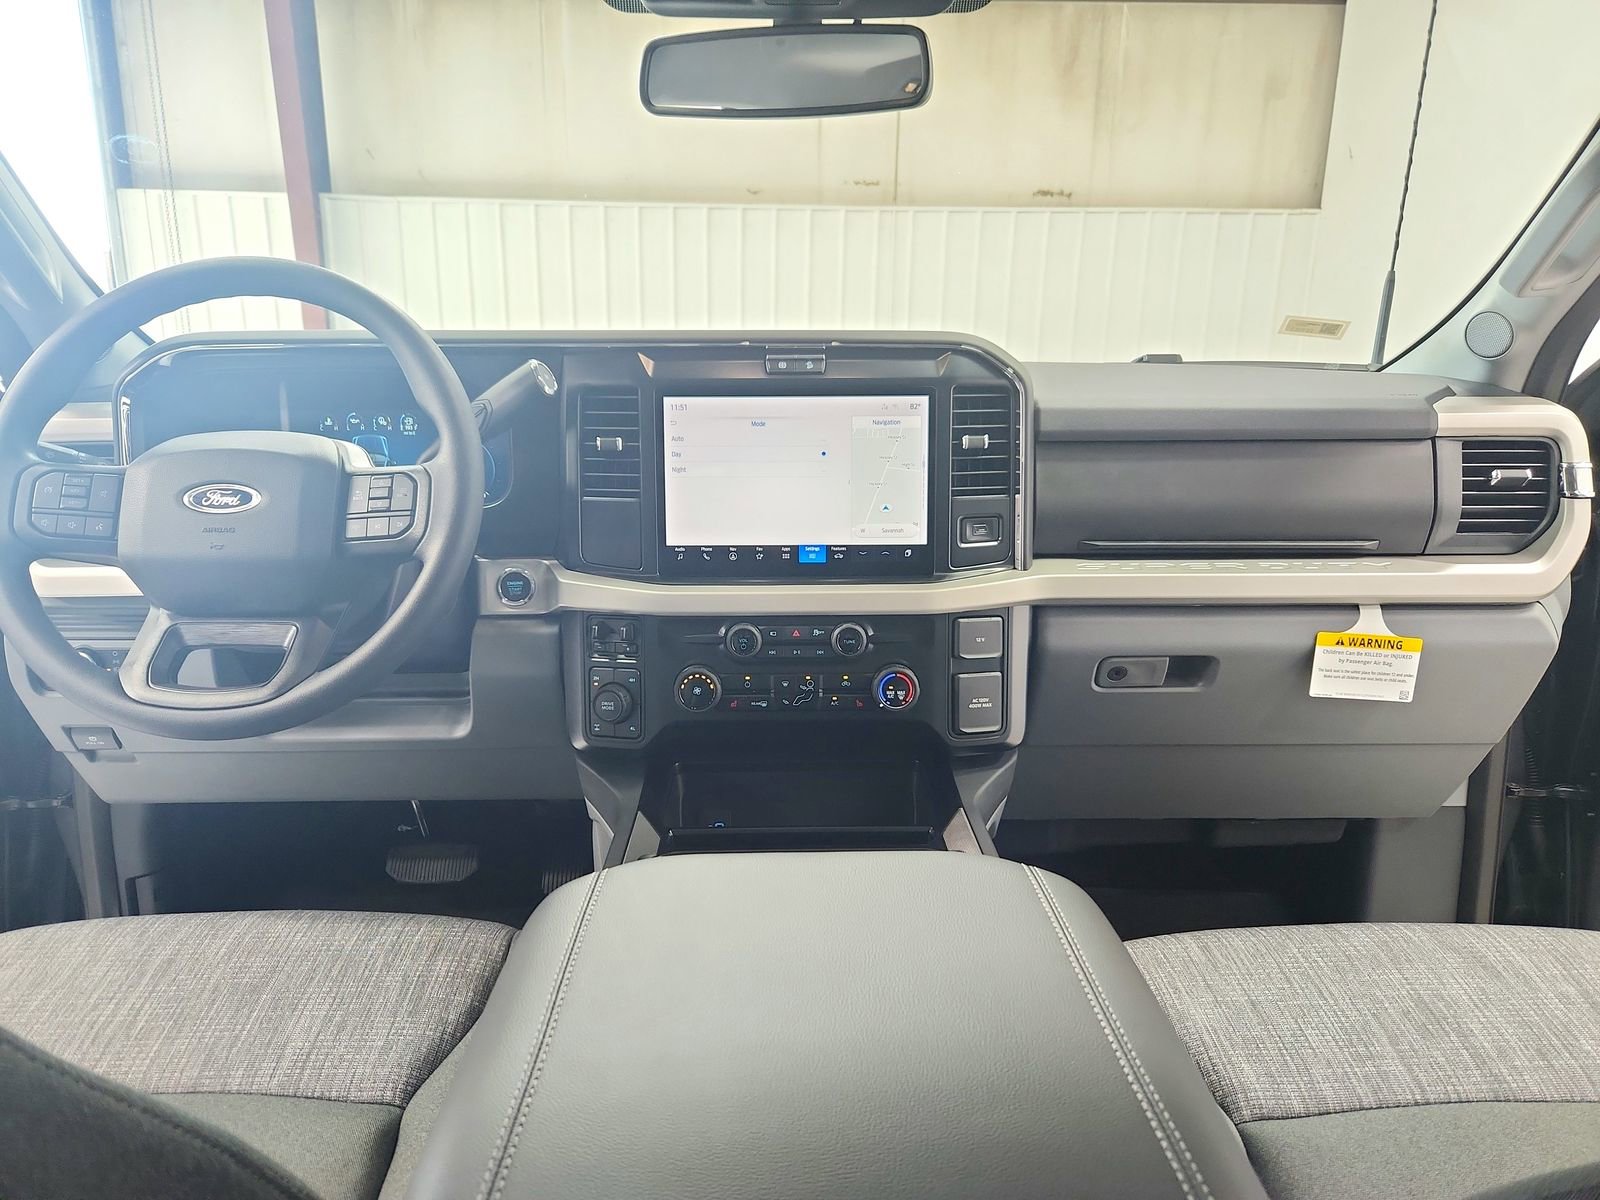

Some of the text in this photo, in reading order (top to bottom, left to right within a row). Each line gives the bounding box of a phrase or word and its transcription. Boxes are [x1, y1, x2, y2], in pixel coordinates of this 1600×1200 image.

[201, 489, 242, 506] Ford
[1077, 561, 1392, 570] SUPER DUTY
[1348, 637, 1404, 650] WARNING
